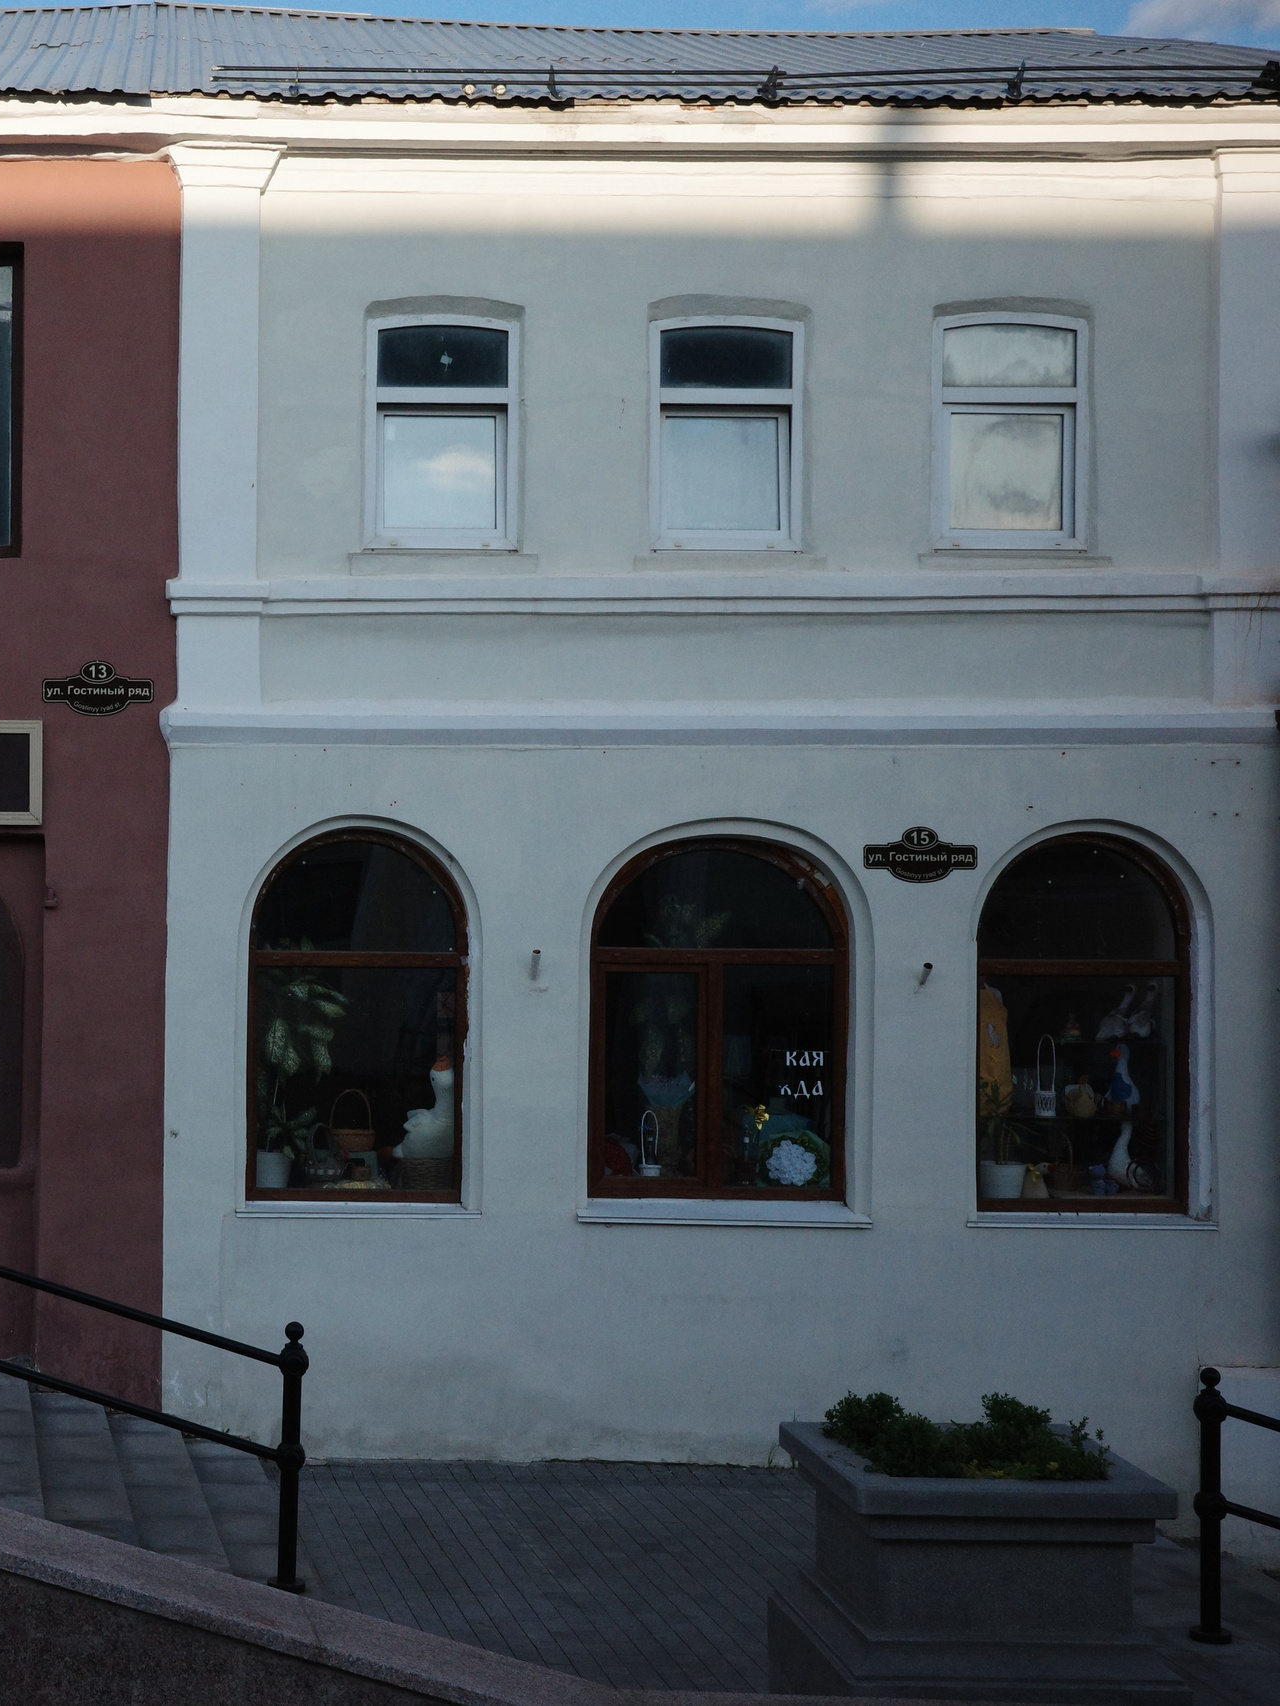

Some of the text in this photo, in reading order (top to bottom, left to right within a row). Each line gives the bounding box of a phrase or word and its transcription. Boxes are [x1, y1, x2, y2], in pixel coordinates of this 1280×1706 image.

[88, 664, 108, 679] 13
[46, 685, 150, 698] ул. Гостиный ряд
[73, 700, 99, 713] Gostinyy
[100, 704, 114, 713] ryad
[910, 831, 930, 845] 15
[868, 851, 974, 864] ул. Гостиный ряд
